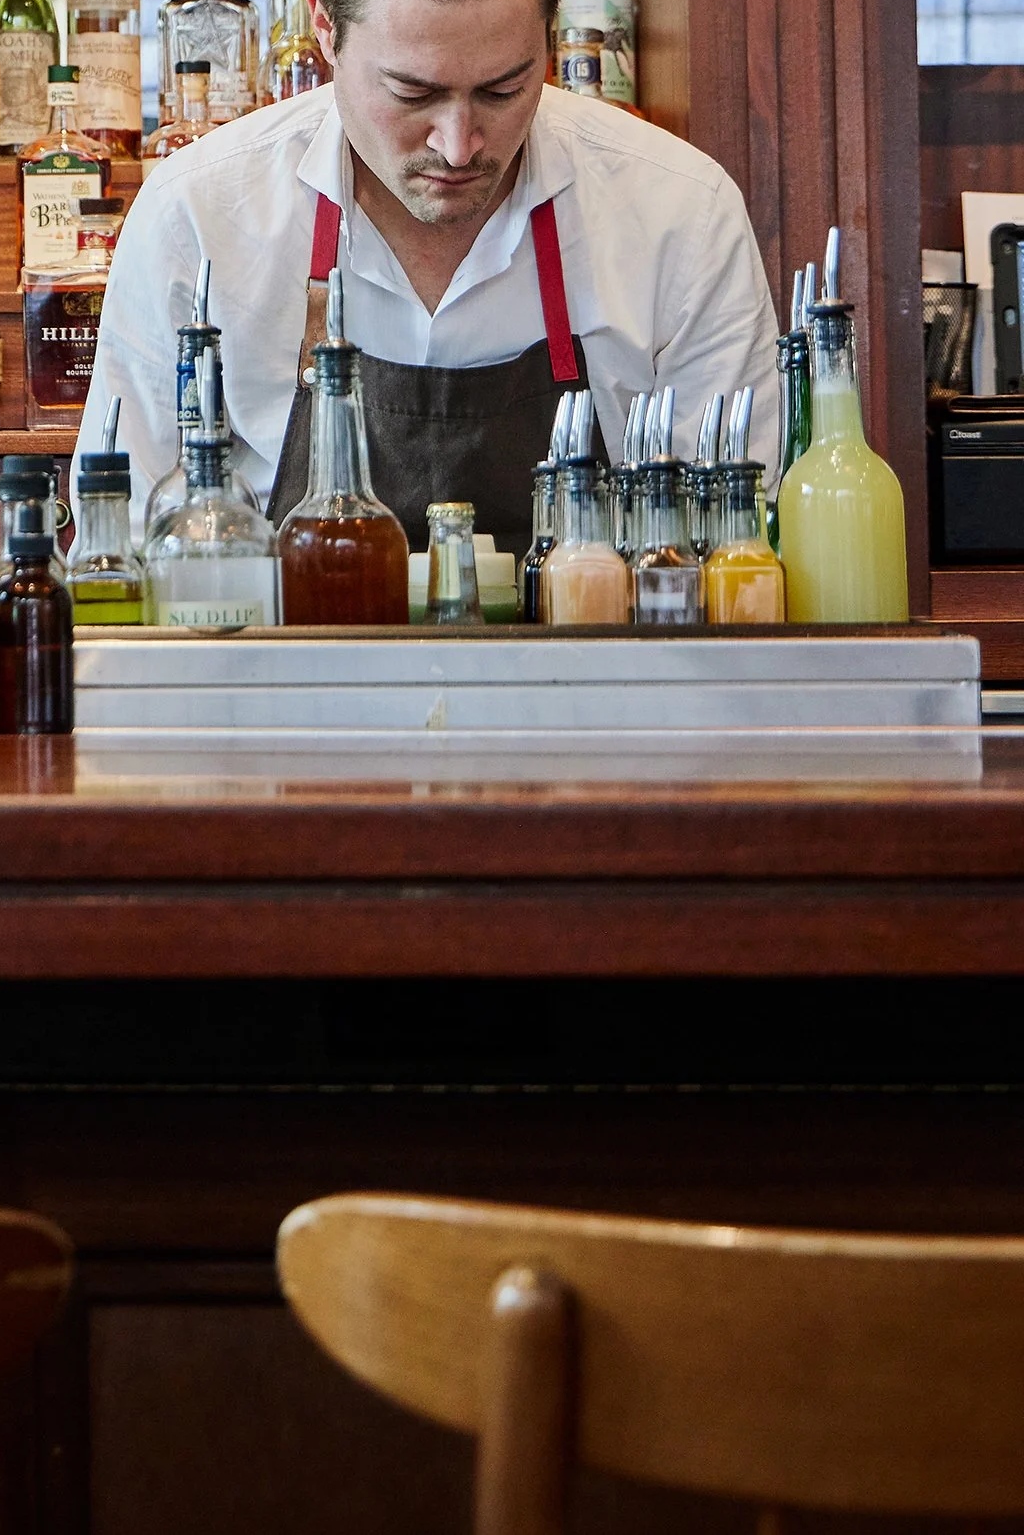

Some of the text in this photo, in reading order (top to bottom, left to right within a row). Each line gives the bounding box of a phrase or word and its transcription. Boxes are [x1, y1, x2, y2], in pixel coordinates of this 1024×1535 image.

[10, 50, 46, 62] MILL
[576, 62, 590, 77] 15
[65, 369, 93, 377] BOURBO
[958, 430, 982, 439] toast
